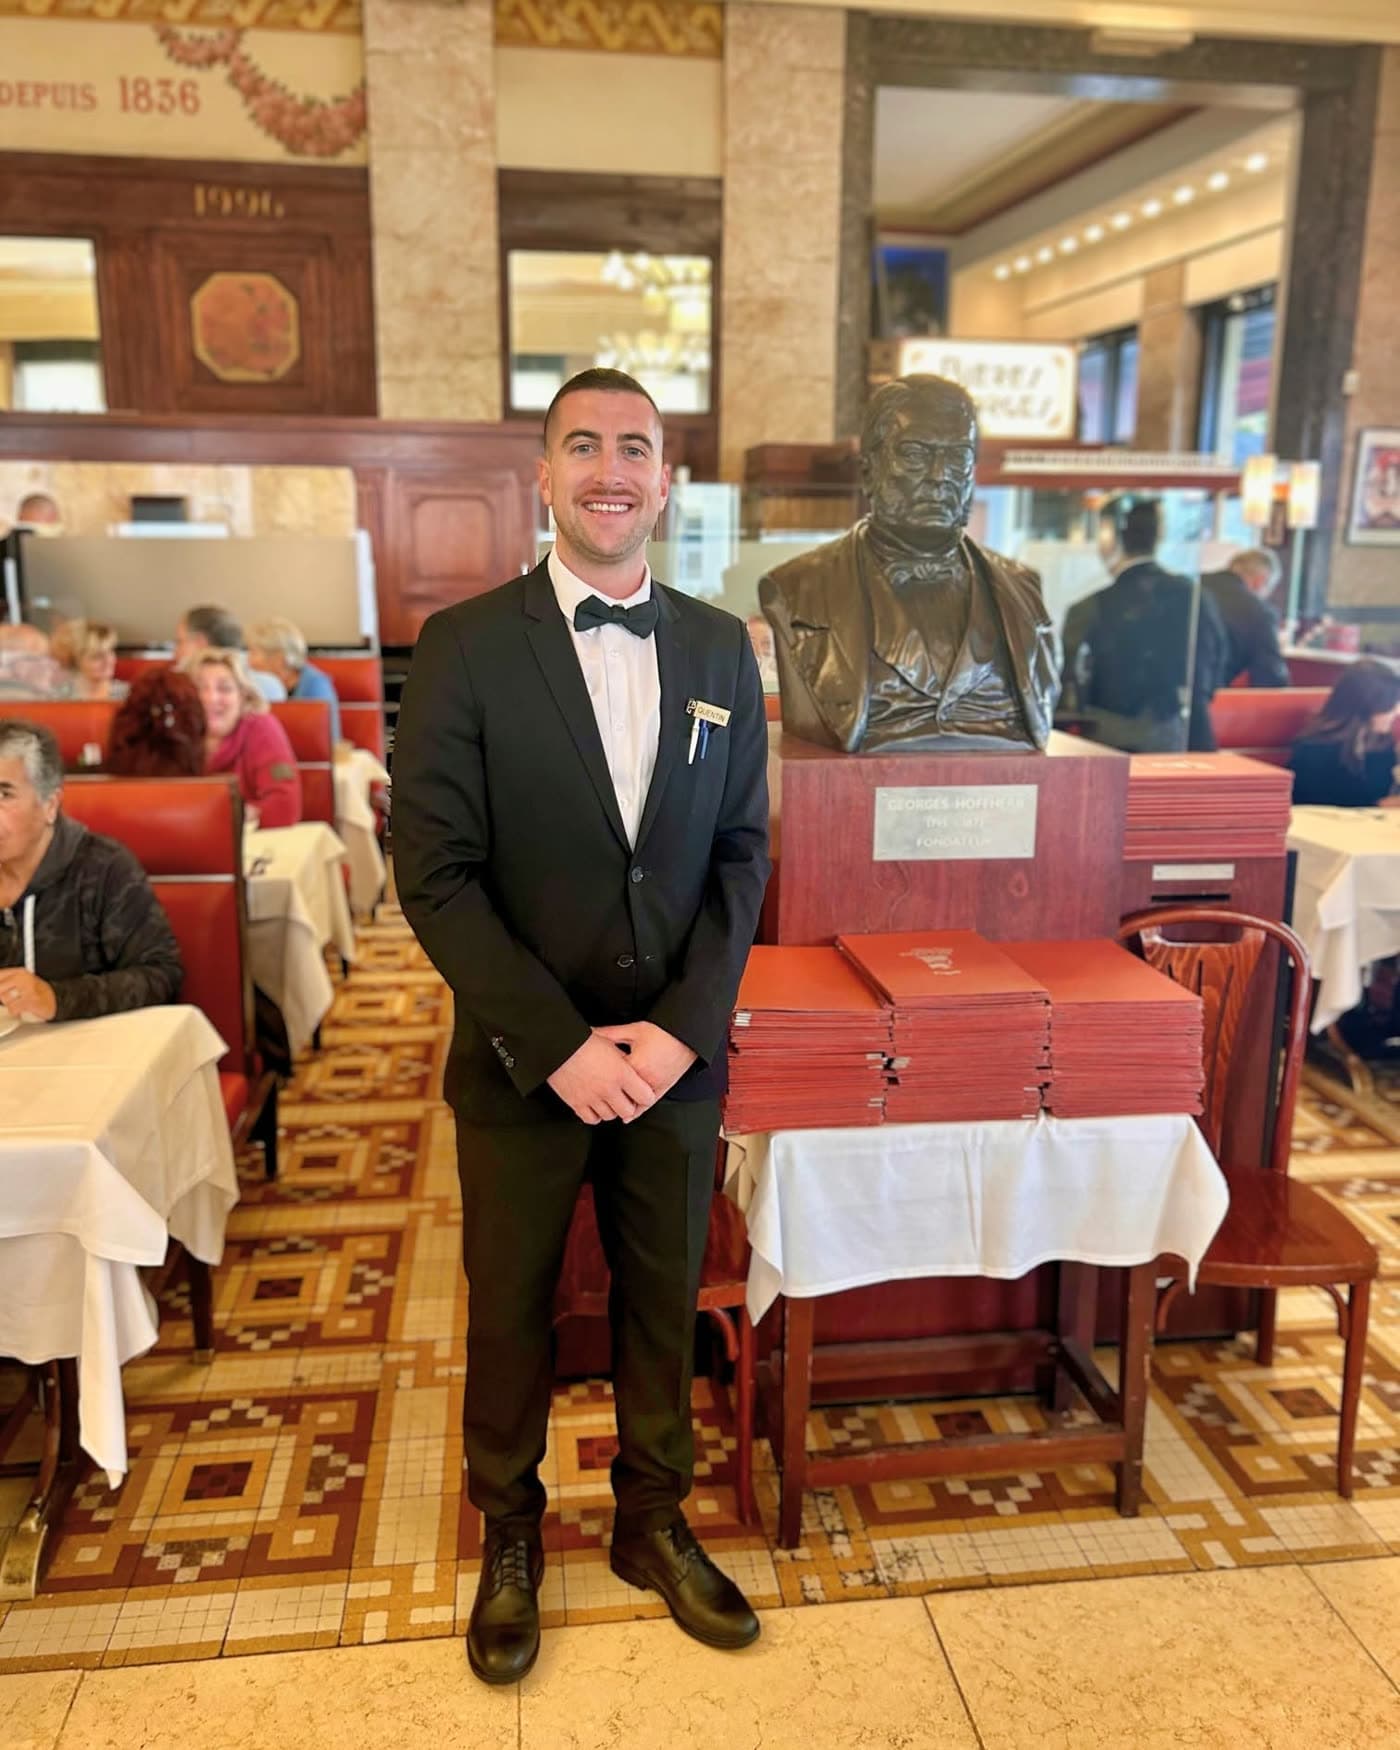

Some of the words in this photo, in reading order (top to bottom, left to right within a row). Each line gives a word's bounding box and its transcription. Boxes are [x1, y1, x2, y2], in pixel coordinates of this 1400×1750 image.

[0, 80, 97, 112] DEPUIS
[118, 76, 202, 116] 1836
[697, 706, 726, 722] QUENTIN
[887, 798, 950, 811] GEORGES
